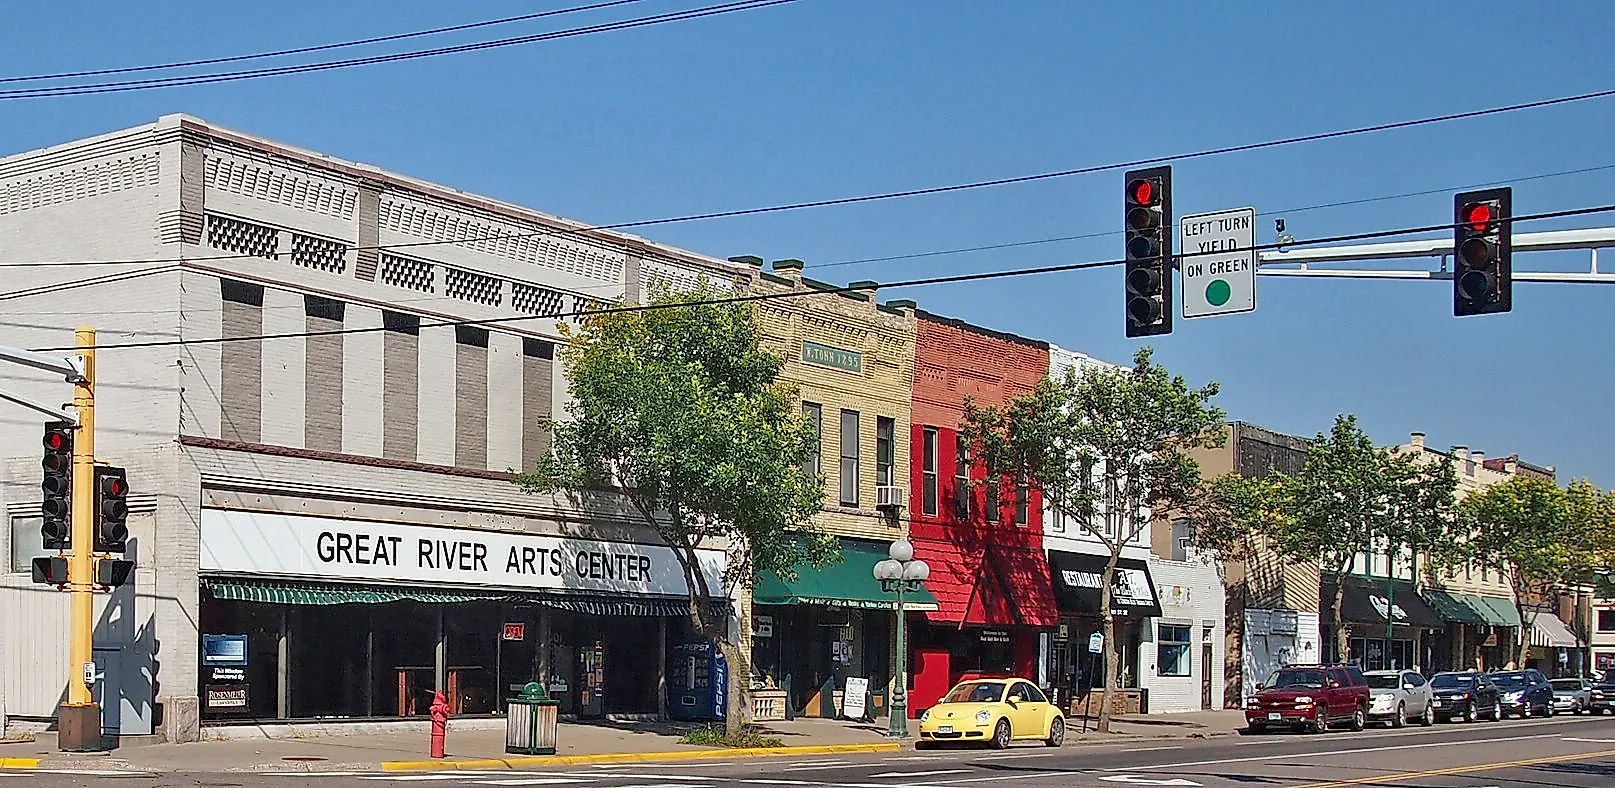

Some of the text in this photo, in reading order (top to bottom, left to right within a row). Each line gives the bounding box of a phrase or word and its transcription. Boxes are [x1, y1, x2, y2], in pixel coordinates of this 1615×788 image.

[1185, 216, 1249, 237] LEFT TURN
[1198, 238, 1237, 253] YIELD
[1187, 258, 1249, 277] ON GREEN
[317, 531, 652, 583] GREAT RIVER ARTS CENTER
[714, 667, 724, 717] PEPSI
